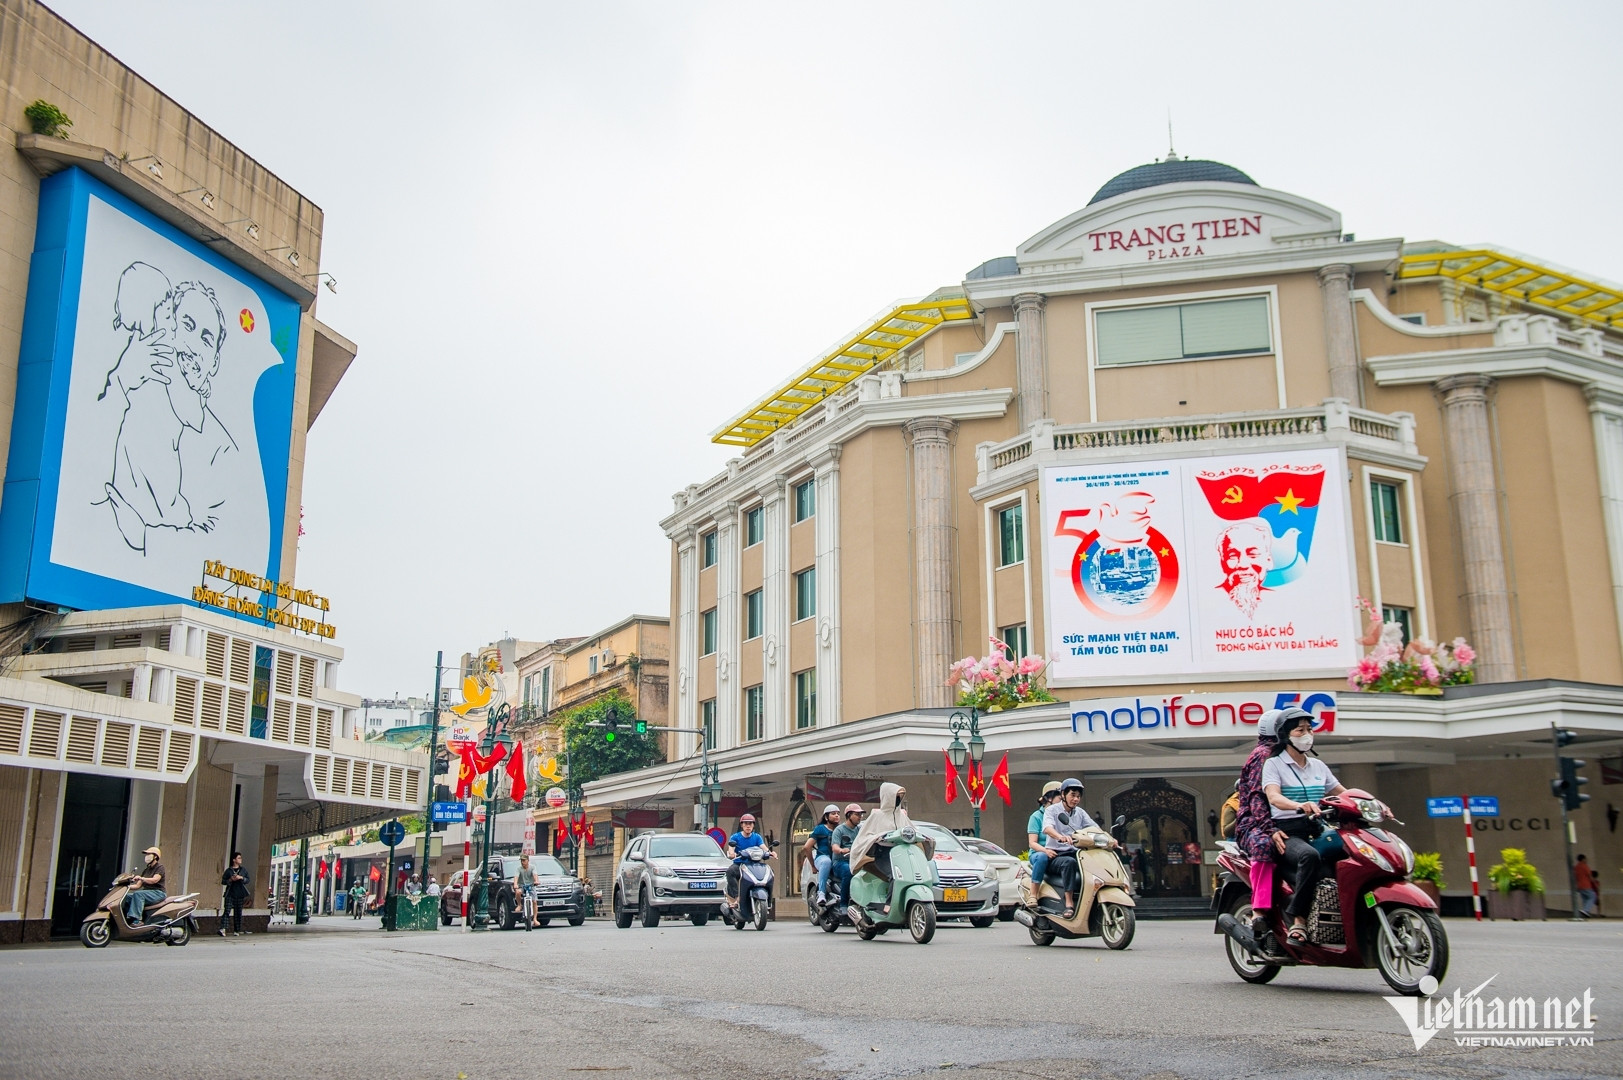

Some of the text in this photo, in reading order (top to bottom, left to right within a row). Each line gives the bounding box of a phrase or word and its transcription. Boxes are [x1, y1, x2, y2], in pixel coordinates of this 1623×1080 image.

[1088, 215, 1262, 252] TRANG TIEN
[1148, 245, 1204, 260] PLAZA
[1200, 464, 1323, 478] 30.4.1975 30.4.2025
[1062, 633, 1084, 644] SỨC
[1088, 634, 1120, 644] MẠNH
[1124, 631, 1147, 643] VIỆT
[1216, 628, 1237, 639] NHƯ
[1240, 626, 1254, 638] CÓ
[1256, 624, 1277, 637] BÁC
[1098, 644, 1119, 655] VÓC
[1122, 643, 1146, 654] THỜI
[1150, 644, 1169, 654] ĐẠI
[1216, 643, 1246, 652] TRONG
[1248, 640, 1272, 651] NGÀY
[1274, 641, 1289, 650] VUI
[1291, 640, 1306, 652] ĐẠI
[1072, 696, 1264, 733] mobifone
[1474, 818, 1551, 832] GUCCI
